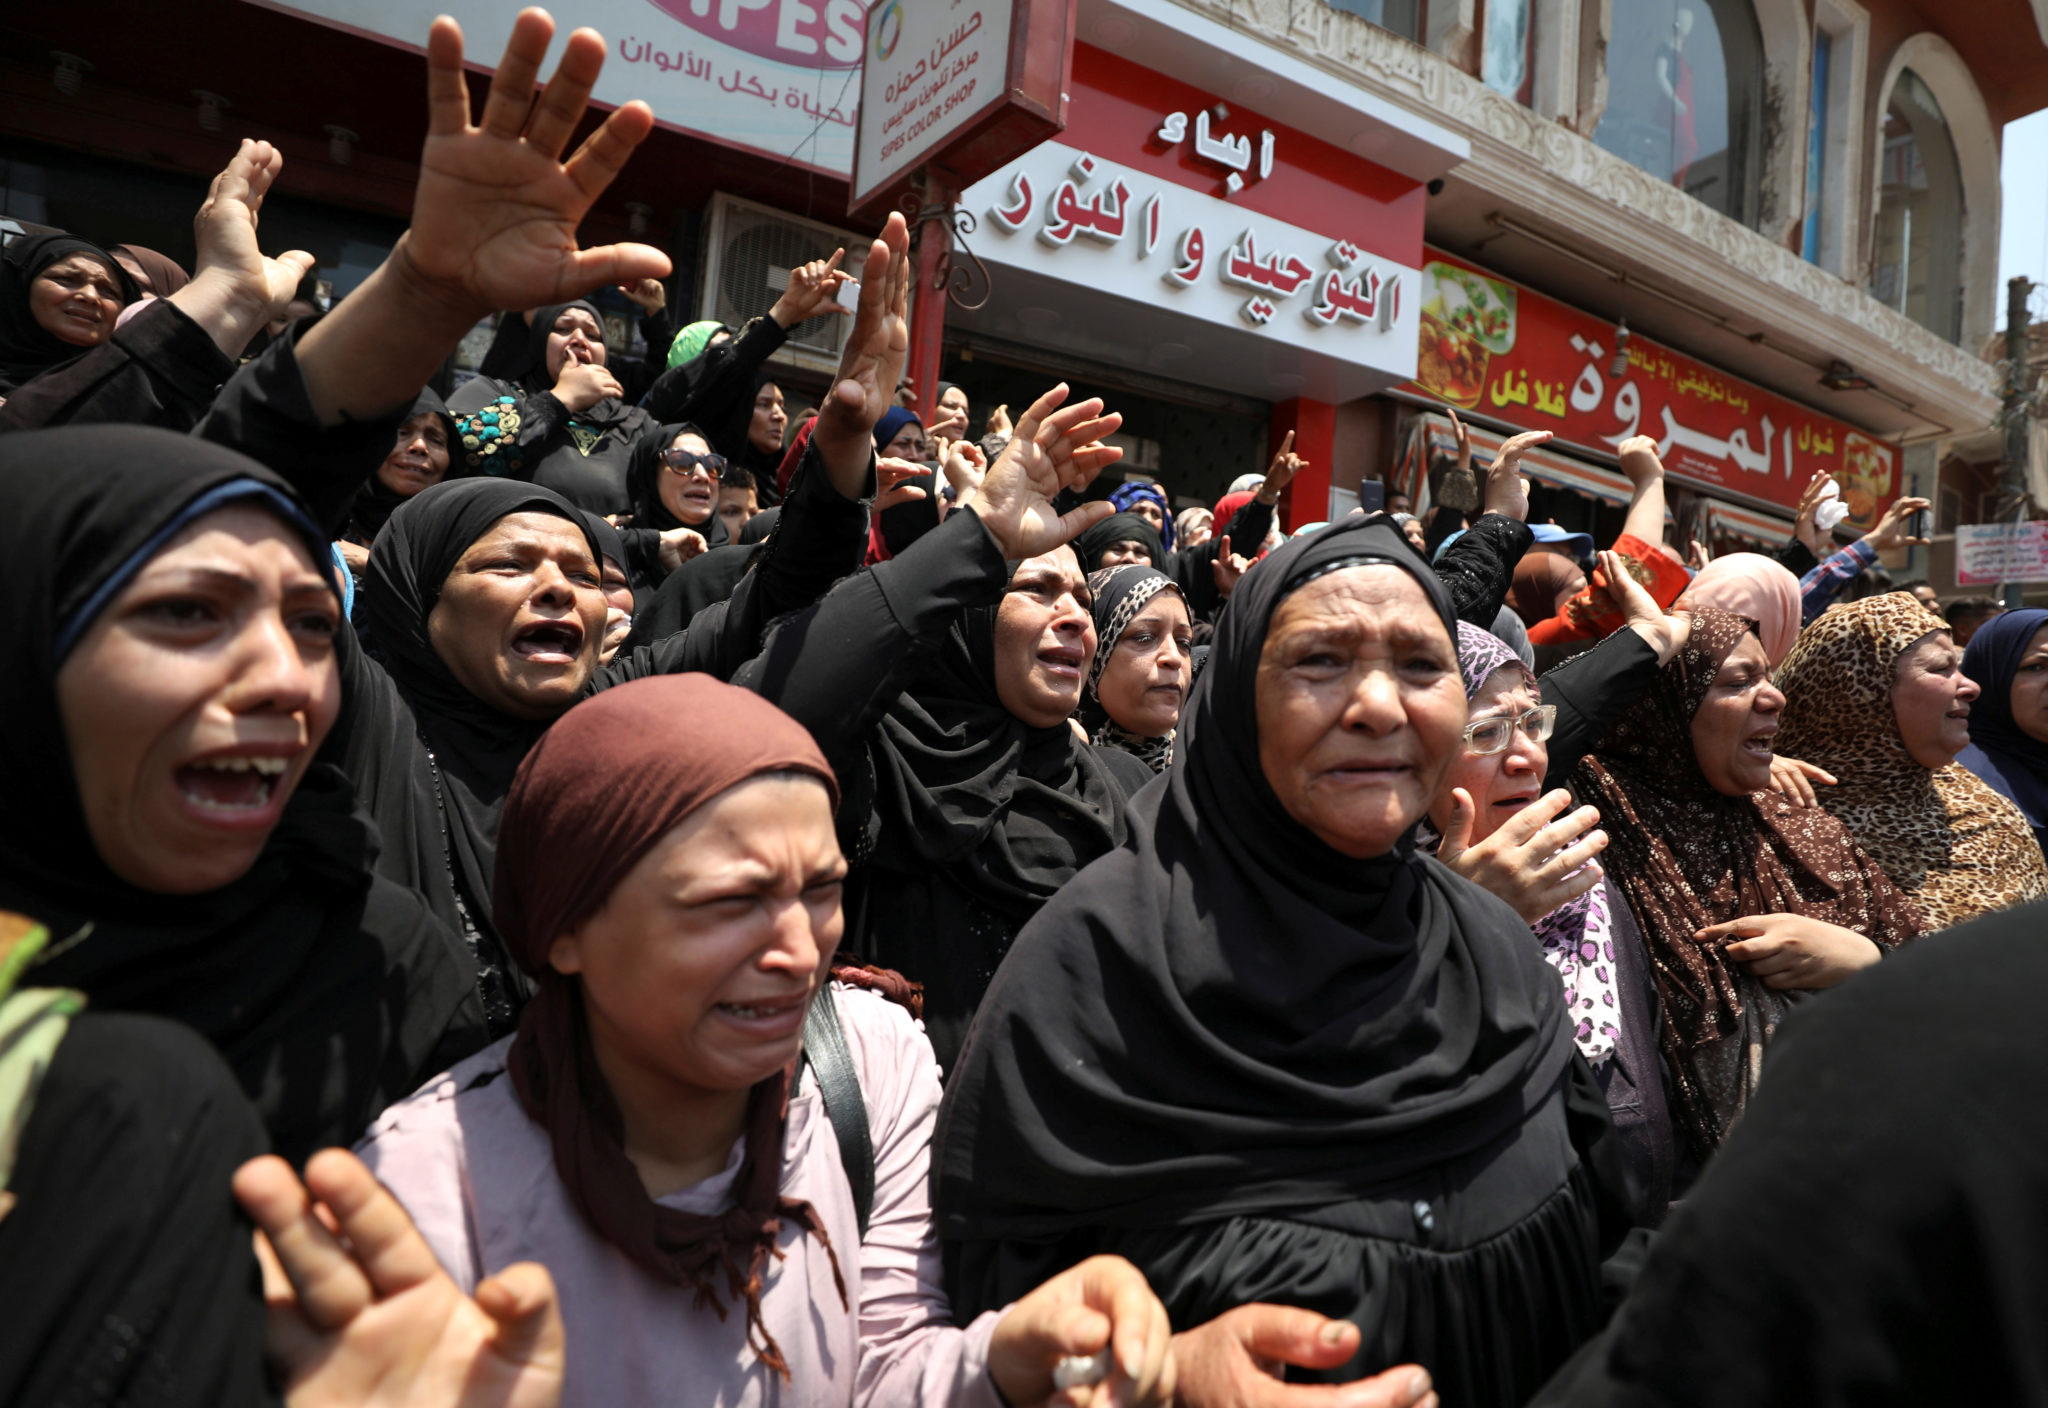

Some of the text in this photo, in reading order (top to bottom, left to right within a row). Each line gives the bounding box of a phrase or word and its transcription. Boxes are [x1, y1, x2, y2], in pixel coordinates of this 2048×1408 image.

[619, 36, 711, 82] الألوان
[928, 10, 982, 71] حسن
[718, 70, 778, 108] بكل
[919, 66, 950, 107] تلوين
[949, 50, 979, 83] مركز
[880, 77, 977, 162] SIPES COLOR SHOP
[991, 150, 1403, 329] التوحيد و النور
[1490, 367, 1566, 418] فلافل
[1570, 333, 1793, 480] المروة
[1726, 388, 1750, 415] وما
[1797, 424, 1834, 456] فول
